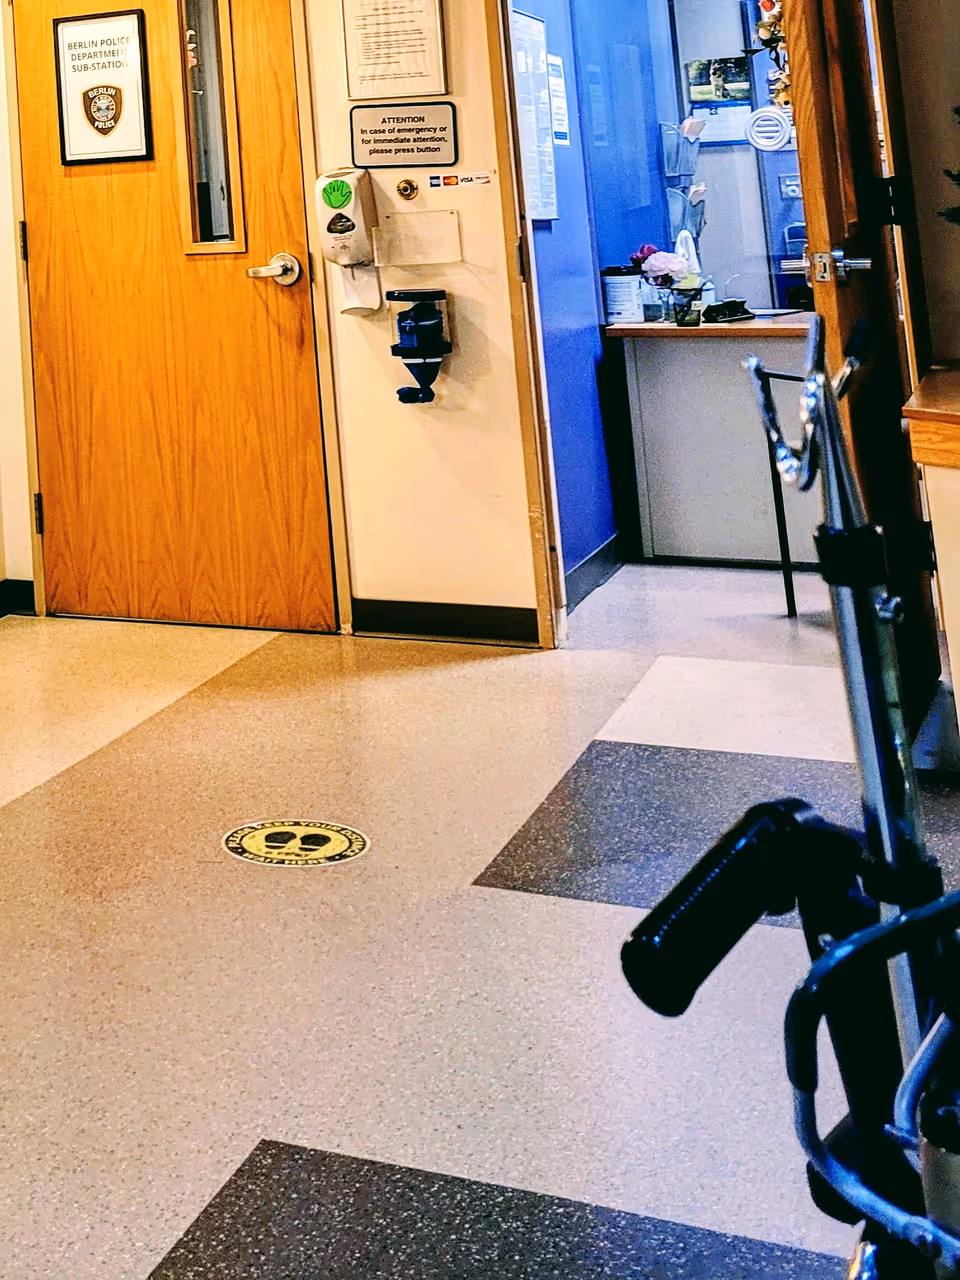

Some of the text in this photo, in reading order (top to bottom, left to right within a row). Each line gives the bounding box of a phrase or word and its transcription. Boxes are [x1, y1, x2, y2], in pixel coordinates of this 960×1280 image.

[67, 36, 131, 50] BERLIN POLICE
[88, 87, 116, 98] BERLIN
[94, 120, 115, 129] POLICE
[381, 116, 425, 124] ATTENTION
[397, 126, 437, 135] emergency
[373, 136, 411, 144] immediate
[412, 135, 448, 143] attention,
[369, 145, 441, 155] please press button
[300, 820, 342, 831] YOUR
